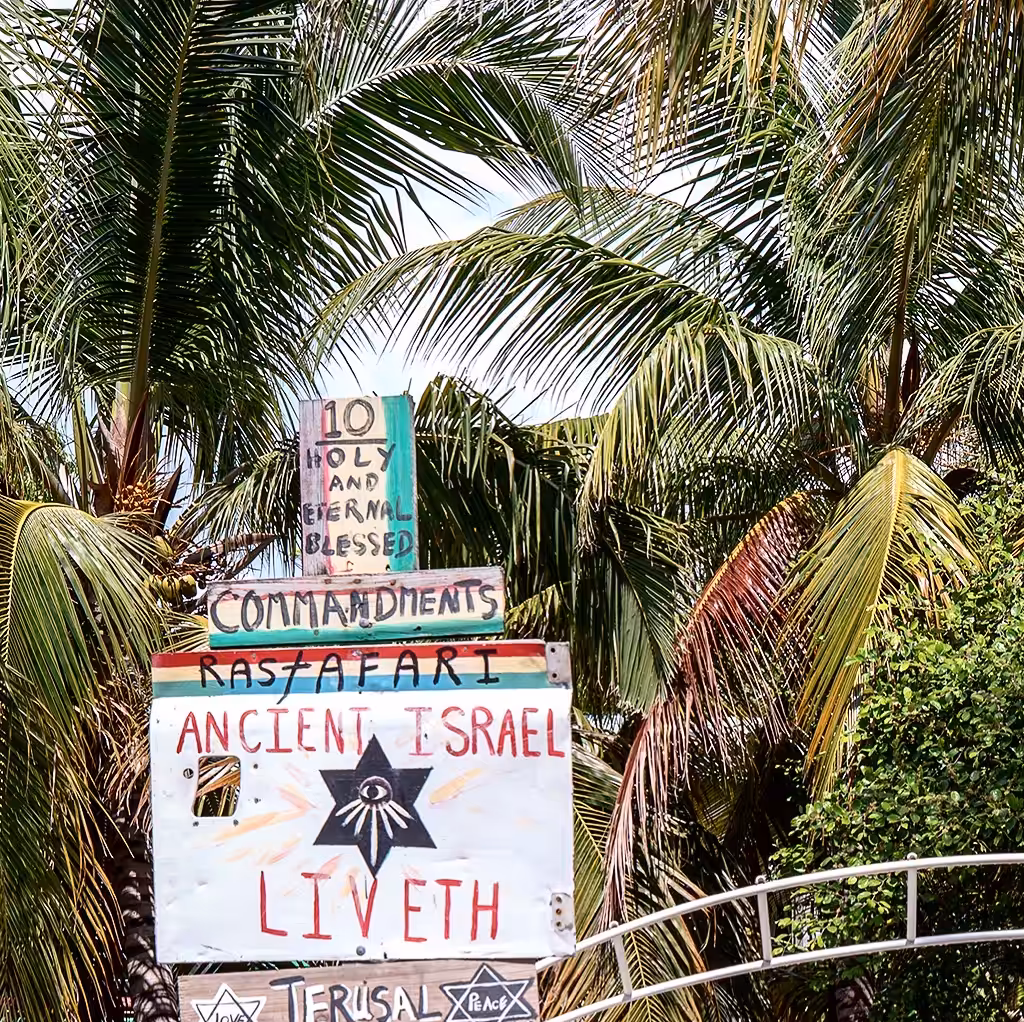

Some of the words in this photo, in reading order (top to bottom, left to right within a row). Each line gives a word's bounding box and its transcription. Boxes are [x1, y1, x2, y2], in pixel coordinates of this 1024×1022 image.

[325, 400, 375, 438] 10
[306, 443, 396, 472] HOLY
[329, 473, 380, 492] AND
[303, 499, 412, 525] ETERNAL
[305, 530, 414, 558] BLESSED
[211, 579, 499, 634] COMMANDMENTS
[176, 707, 370, 755] ANCIENT
[403, 706, 567, 758] ISRAEL
[259, 870, 500, 942] LIVETH
[467, 991, 508, 1013] PEACE
